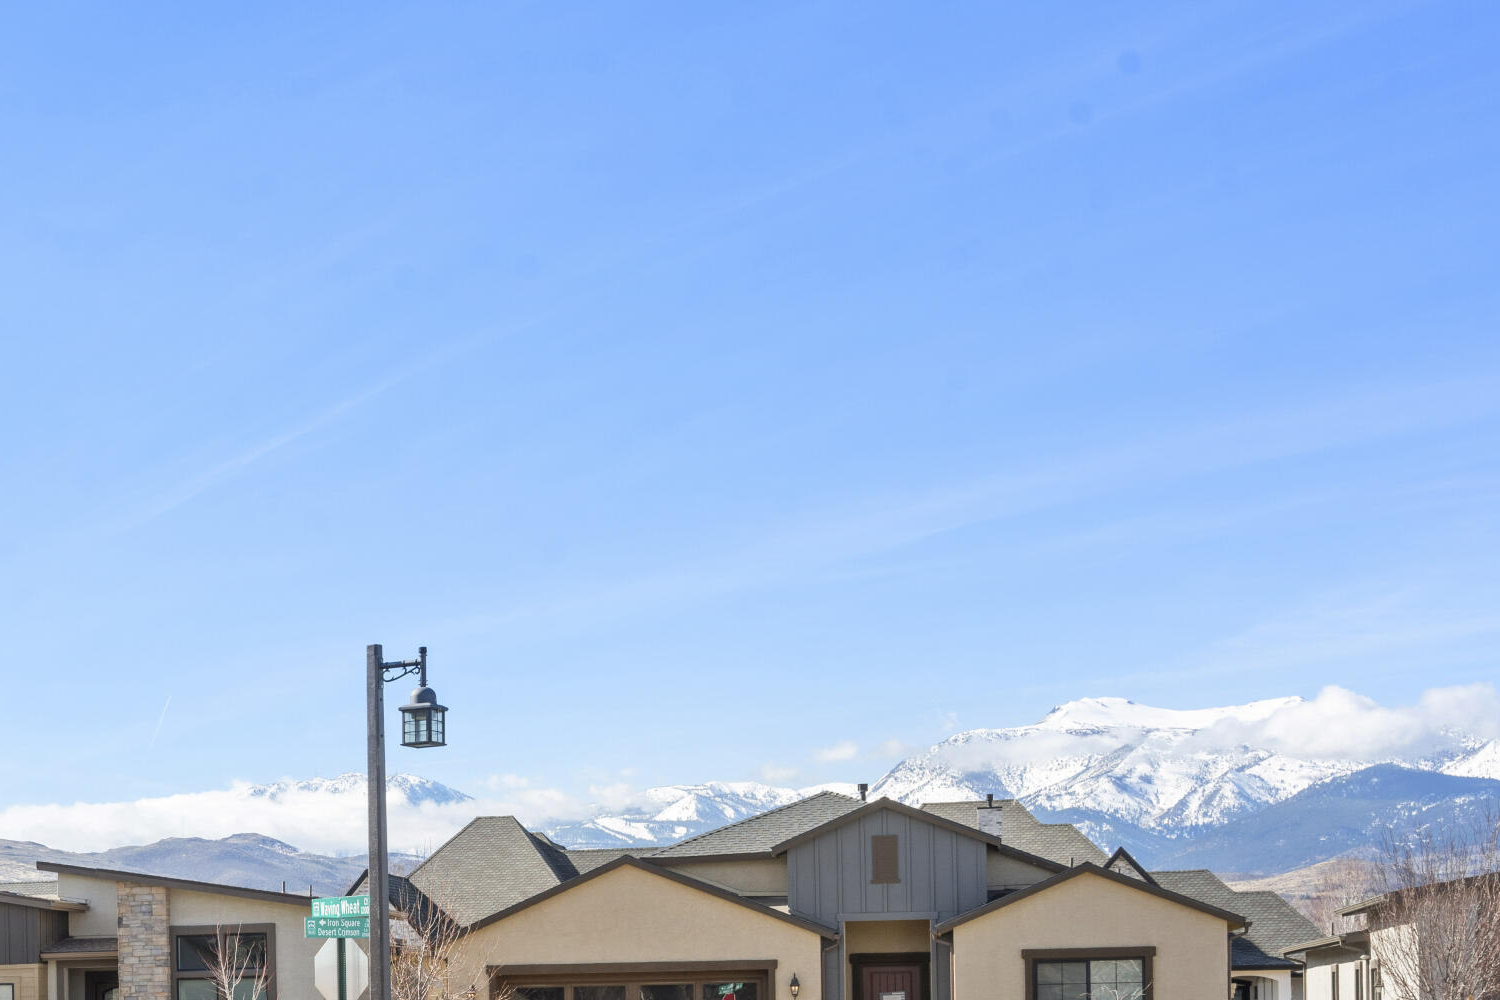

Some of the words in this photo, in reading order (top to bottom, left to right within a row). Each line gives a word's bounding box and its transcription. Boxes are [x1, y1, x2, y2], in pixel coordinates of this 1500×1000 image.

[320, 901, 340, 917] Waving
[340, 899, 360, 915] Wheat
[327, 919, 340, 927] Iron
[340, 919, 360, 929] Square
[317, 928, 337, 936] Desert
